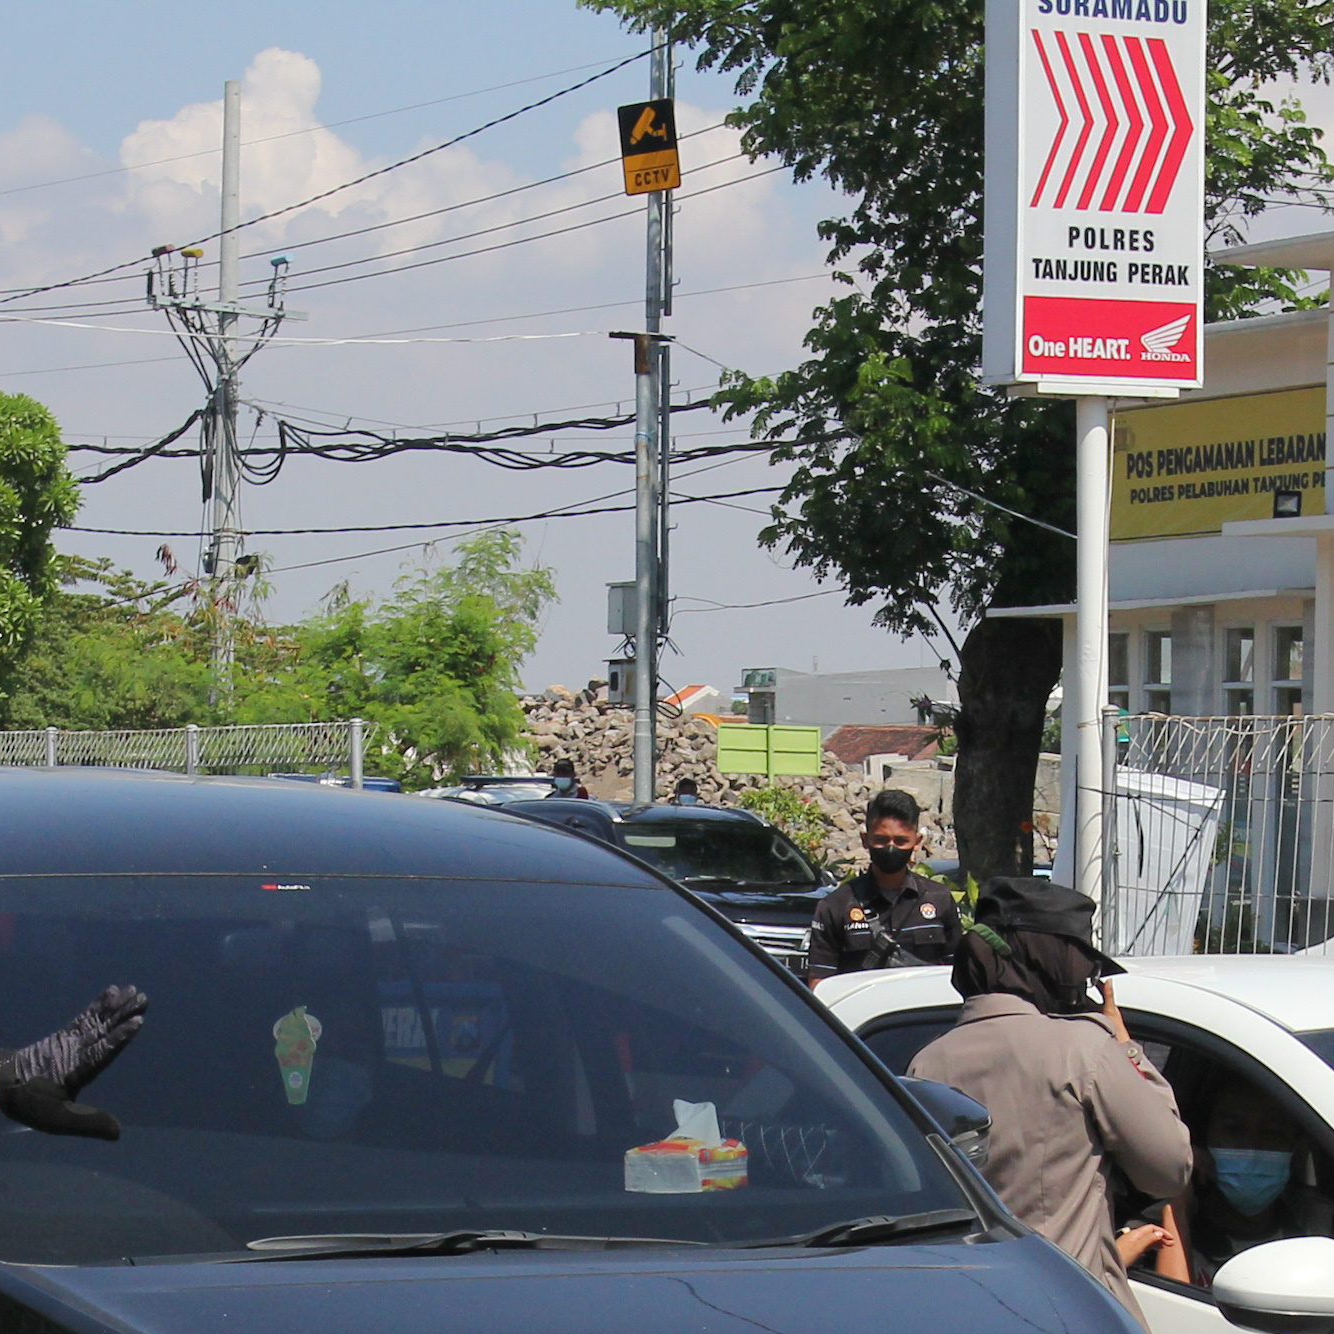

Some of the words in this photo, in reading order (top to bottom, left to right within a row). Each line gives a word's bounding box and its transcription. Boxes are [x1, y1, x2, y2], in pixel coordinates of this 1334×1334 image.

[1037, 0, 1187, 24] SURAMADU
[634, 168, 670, 187] CCTV
[1068, 226, 1155, 252] POLRES
[1032, 258, 1117, 282] TANJUNG
[1128, 263, 1190, 286] PERAK
[1028, 334, 1066, 358] One
[1068, 337, 1131, 360] HEART.
[1140, 352, 1192, 363] HONDA
[1126, 451, 1154, 480] POS
[1157, 439, 1255, 477] PENGAMANAN
[1259, 432, 1326, 467] LEBARAN
[1130, 485, 1174, 505] POLRES
[1178, 477, 1249, 501] PELABUHAN
[1253, 472, 1309, 494] TANJUNG
